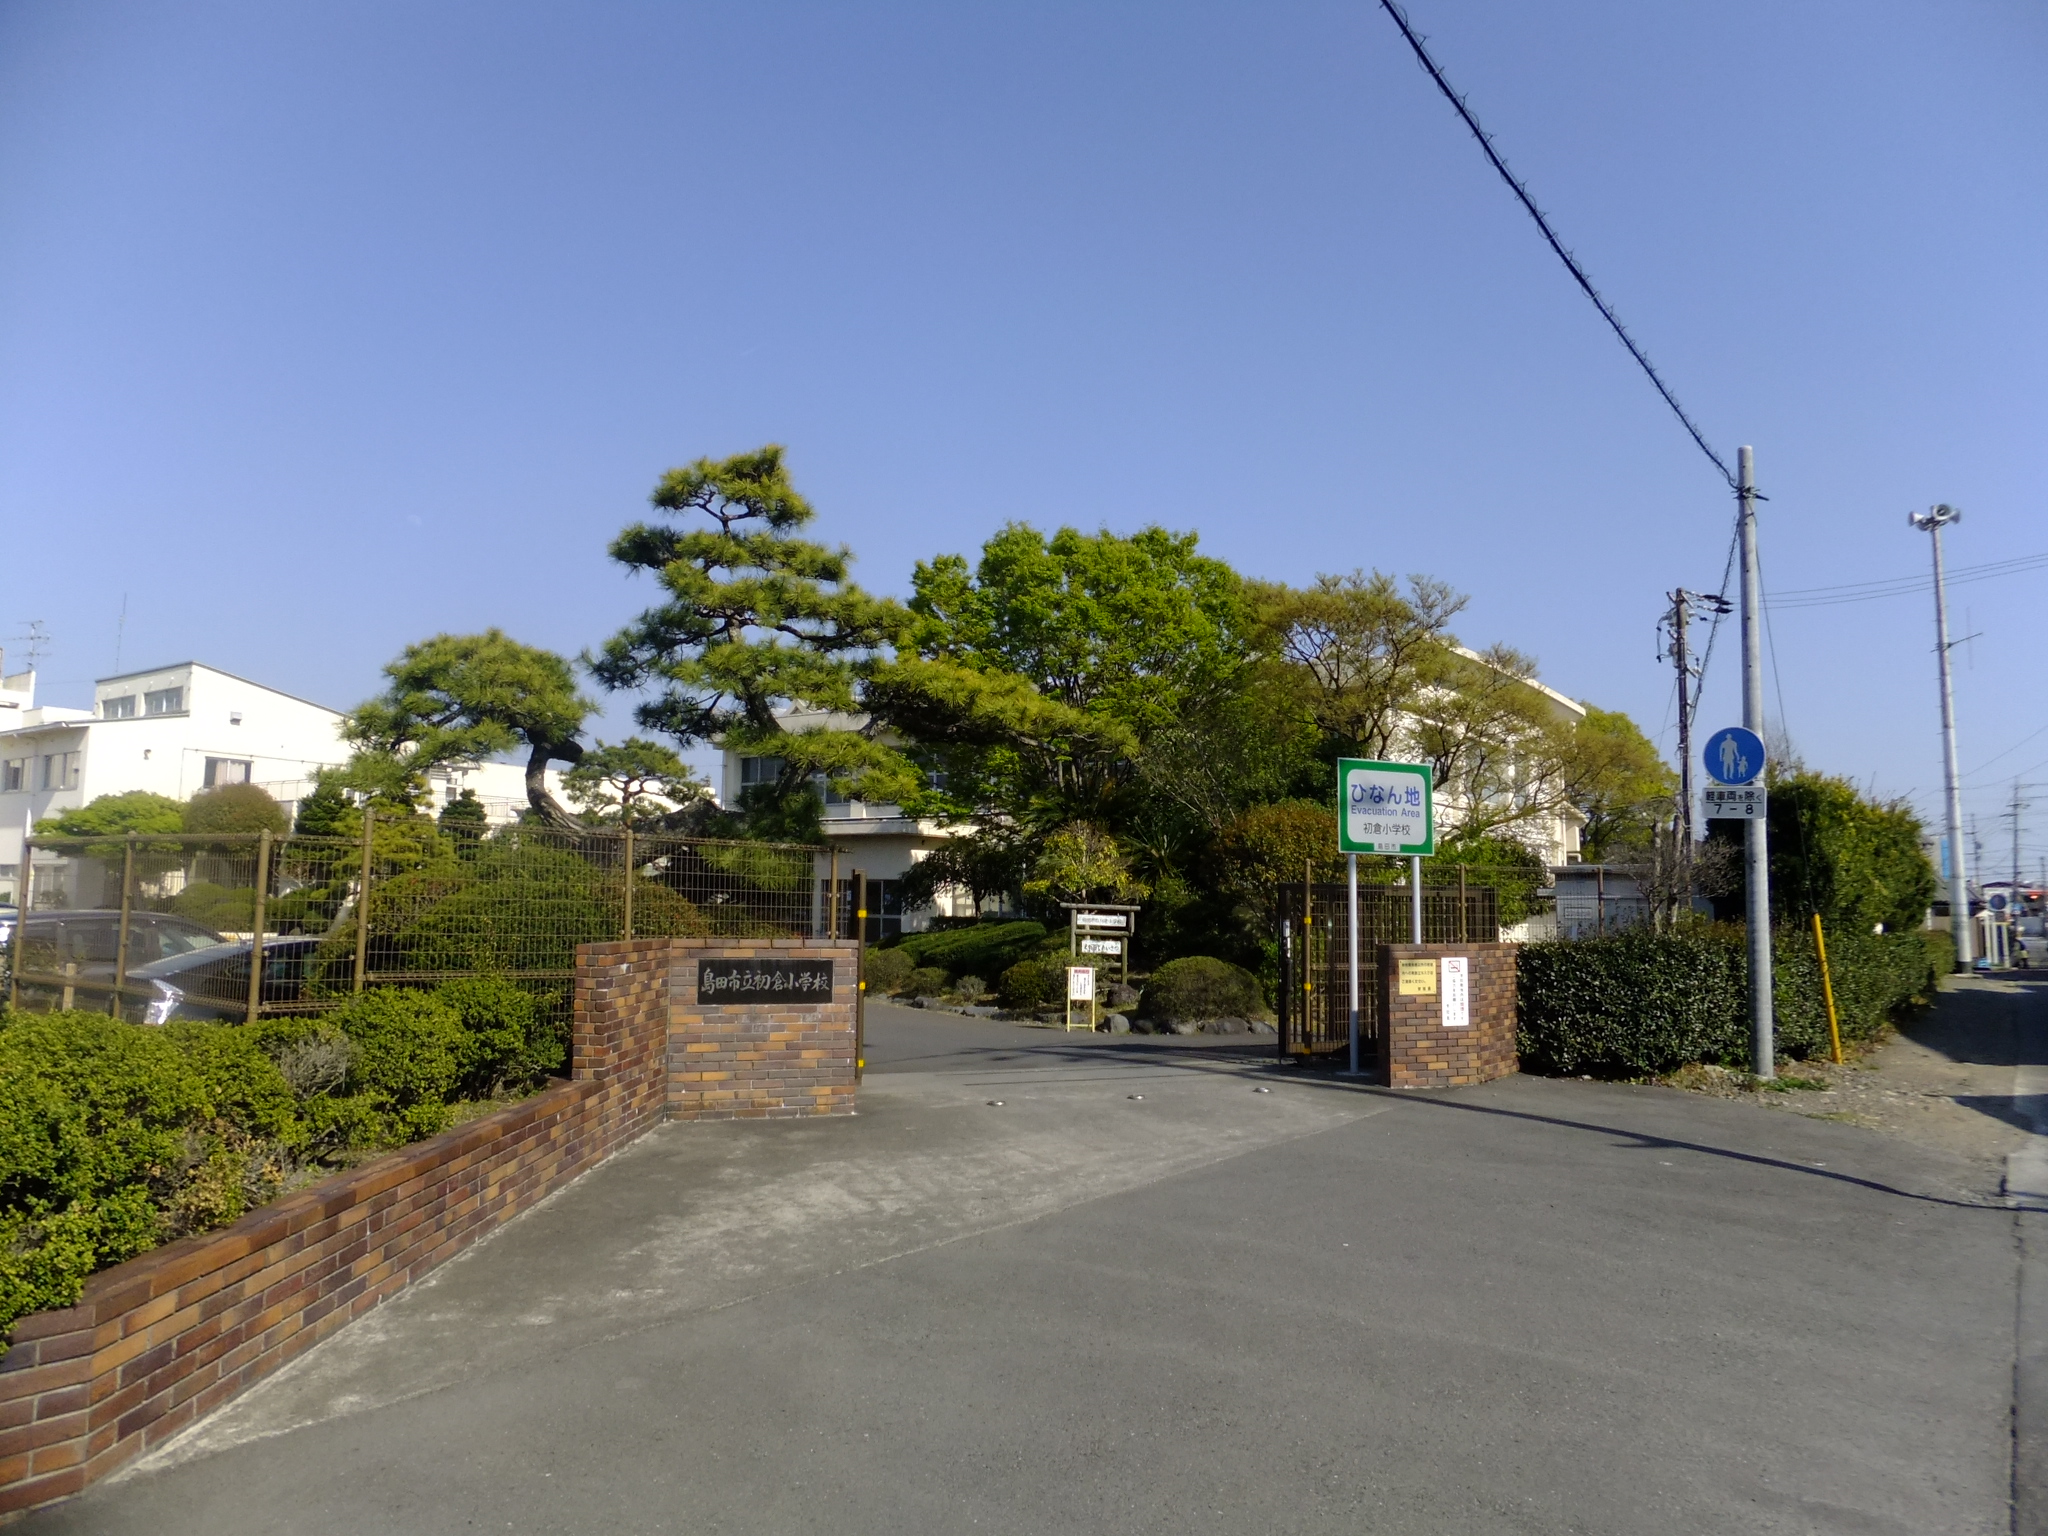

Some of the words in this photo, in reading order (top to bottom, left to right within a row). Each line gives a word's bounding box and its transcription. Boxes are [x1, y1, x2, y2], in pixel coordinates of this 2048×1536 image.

[1351, 784, 1420, 806] ひなん地
[1706, 791, 1762, 802] 軽車両を除く
[1351, 805, 1397, 817] Evacuation
[1401, 808, 1420, 818] Area
[1364, 823, 1411, 835] 初倉小学校
[701, 966, 830, 995] 島田市立初倉小学校
